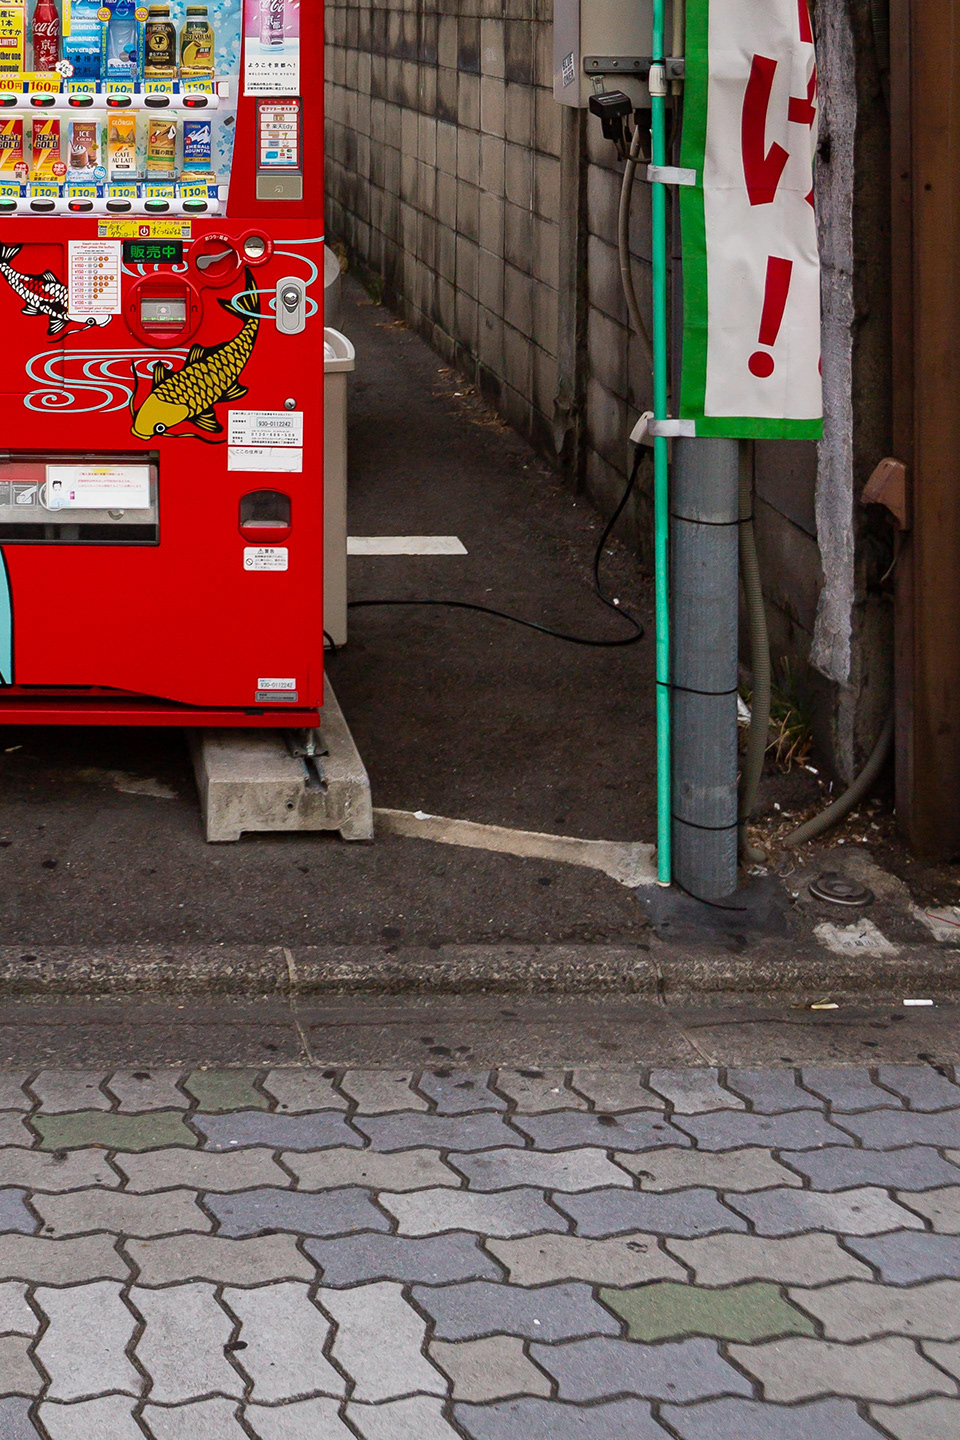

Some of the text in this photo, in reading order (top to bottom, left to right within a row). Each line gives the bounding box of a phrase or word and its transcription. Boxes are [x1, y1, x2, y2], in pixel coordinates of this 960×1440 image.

[31, 81, 59, 92] 160円
[34, 188, 57, 197] 130円
[72, 189, 96, 197] 130円
[112, 189, 136, 197] 130円
[183, 187, 207, 196] 130円
[130, 245, 176, 259] 販売中
